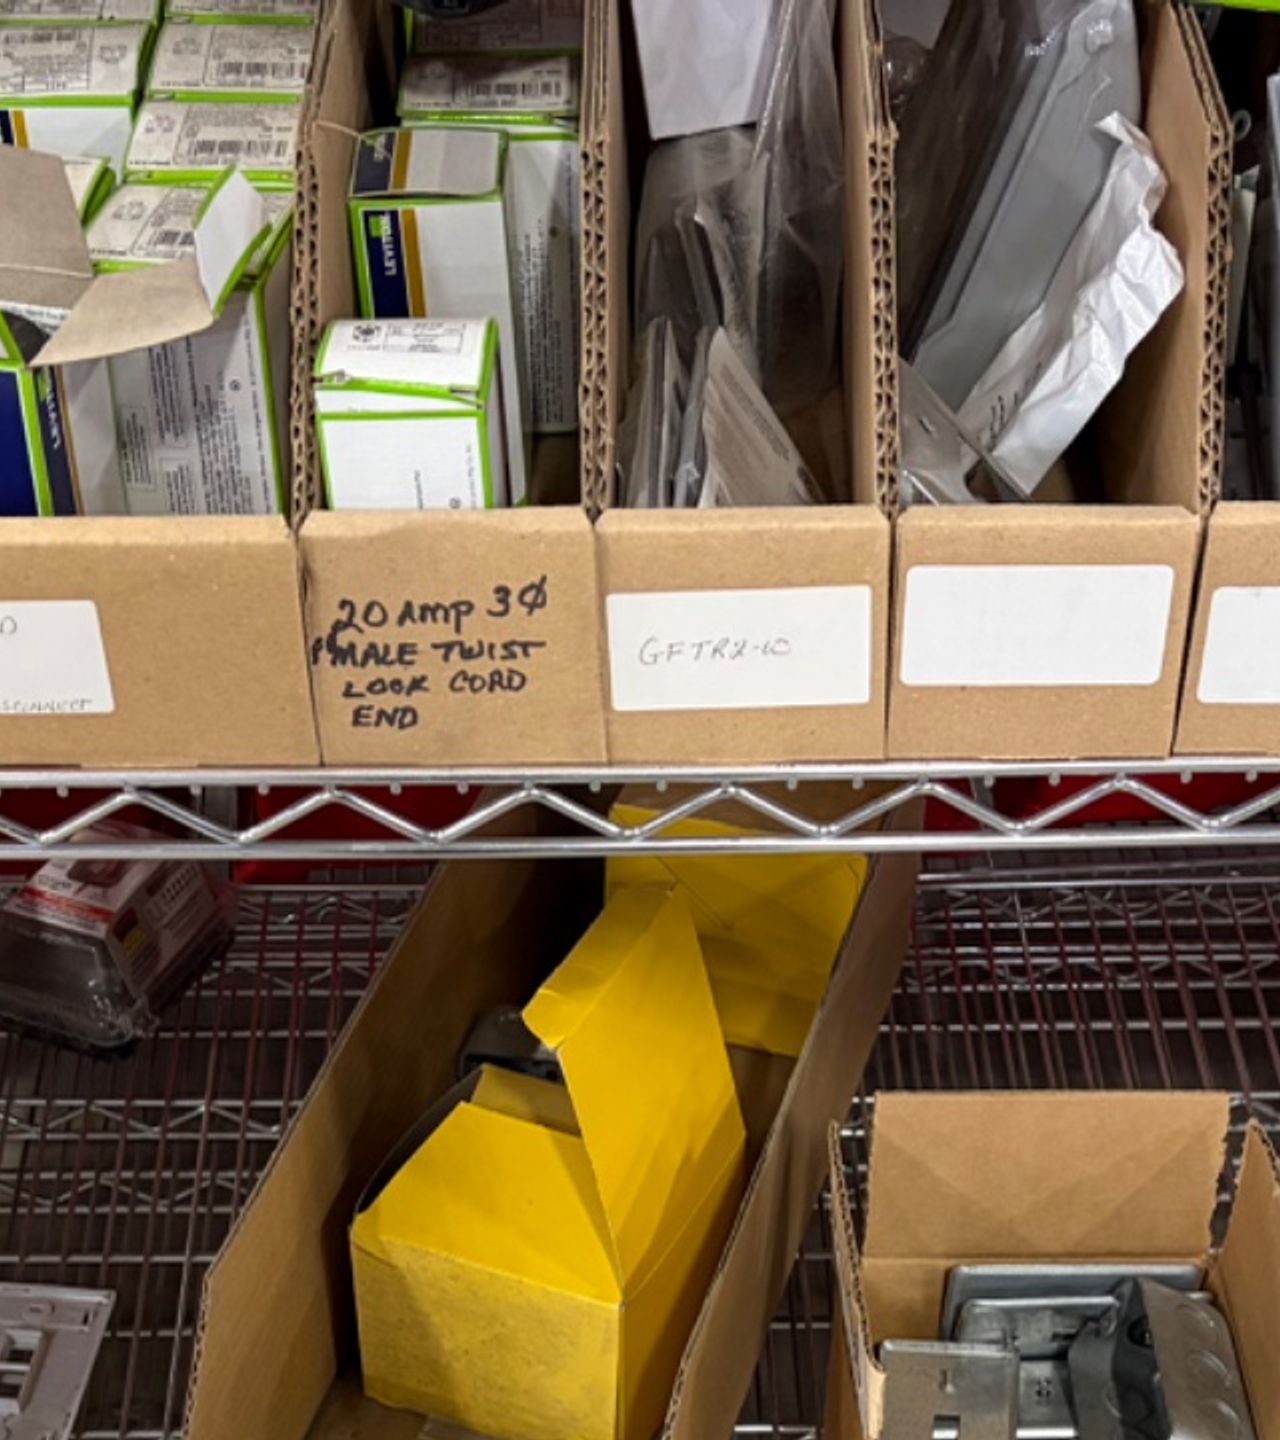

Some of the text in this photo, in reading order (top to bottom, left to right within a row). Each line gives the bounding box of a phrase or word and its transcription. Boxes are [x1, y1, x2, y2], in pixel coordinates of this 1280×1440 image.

[381, 213, 398, 277] LEVITON
[431, 639, 547, 663] TWIST
[449, 669, 527, 693] CORD
[352, 705, 418, 729] END
